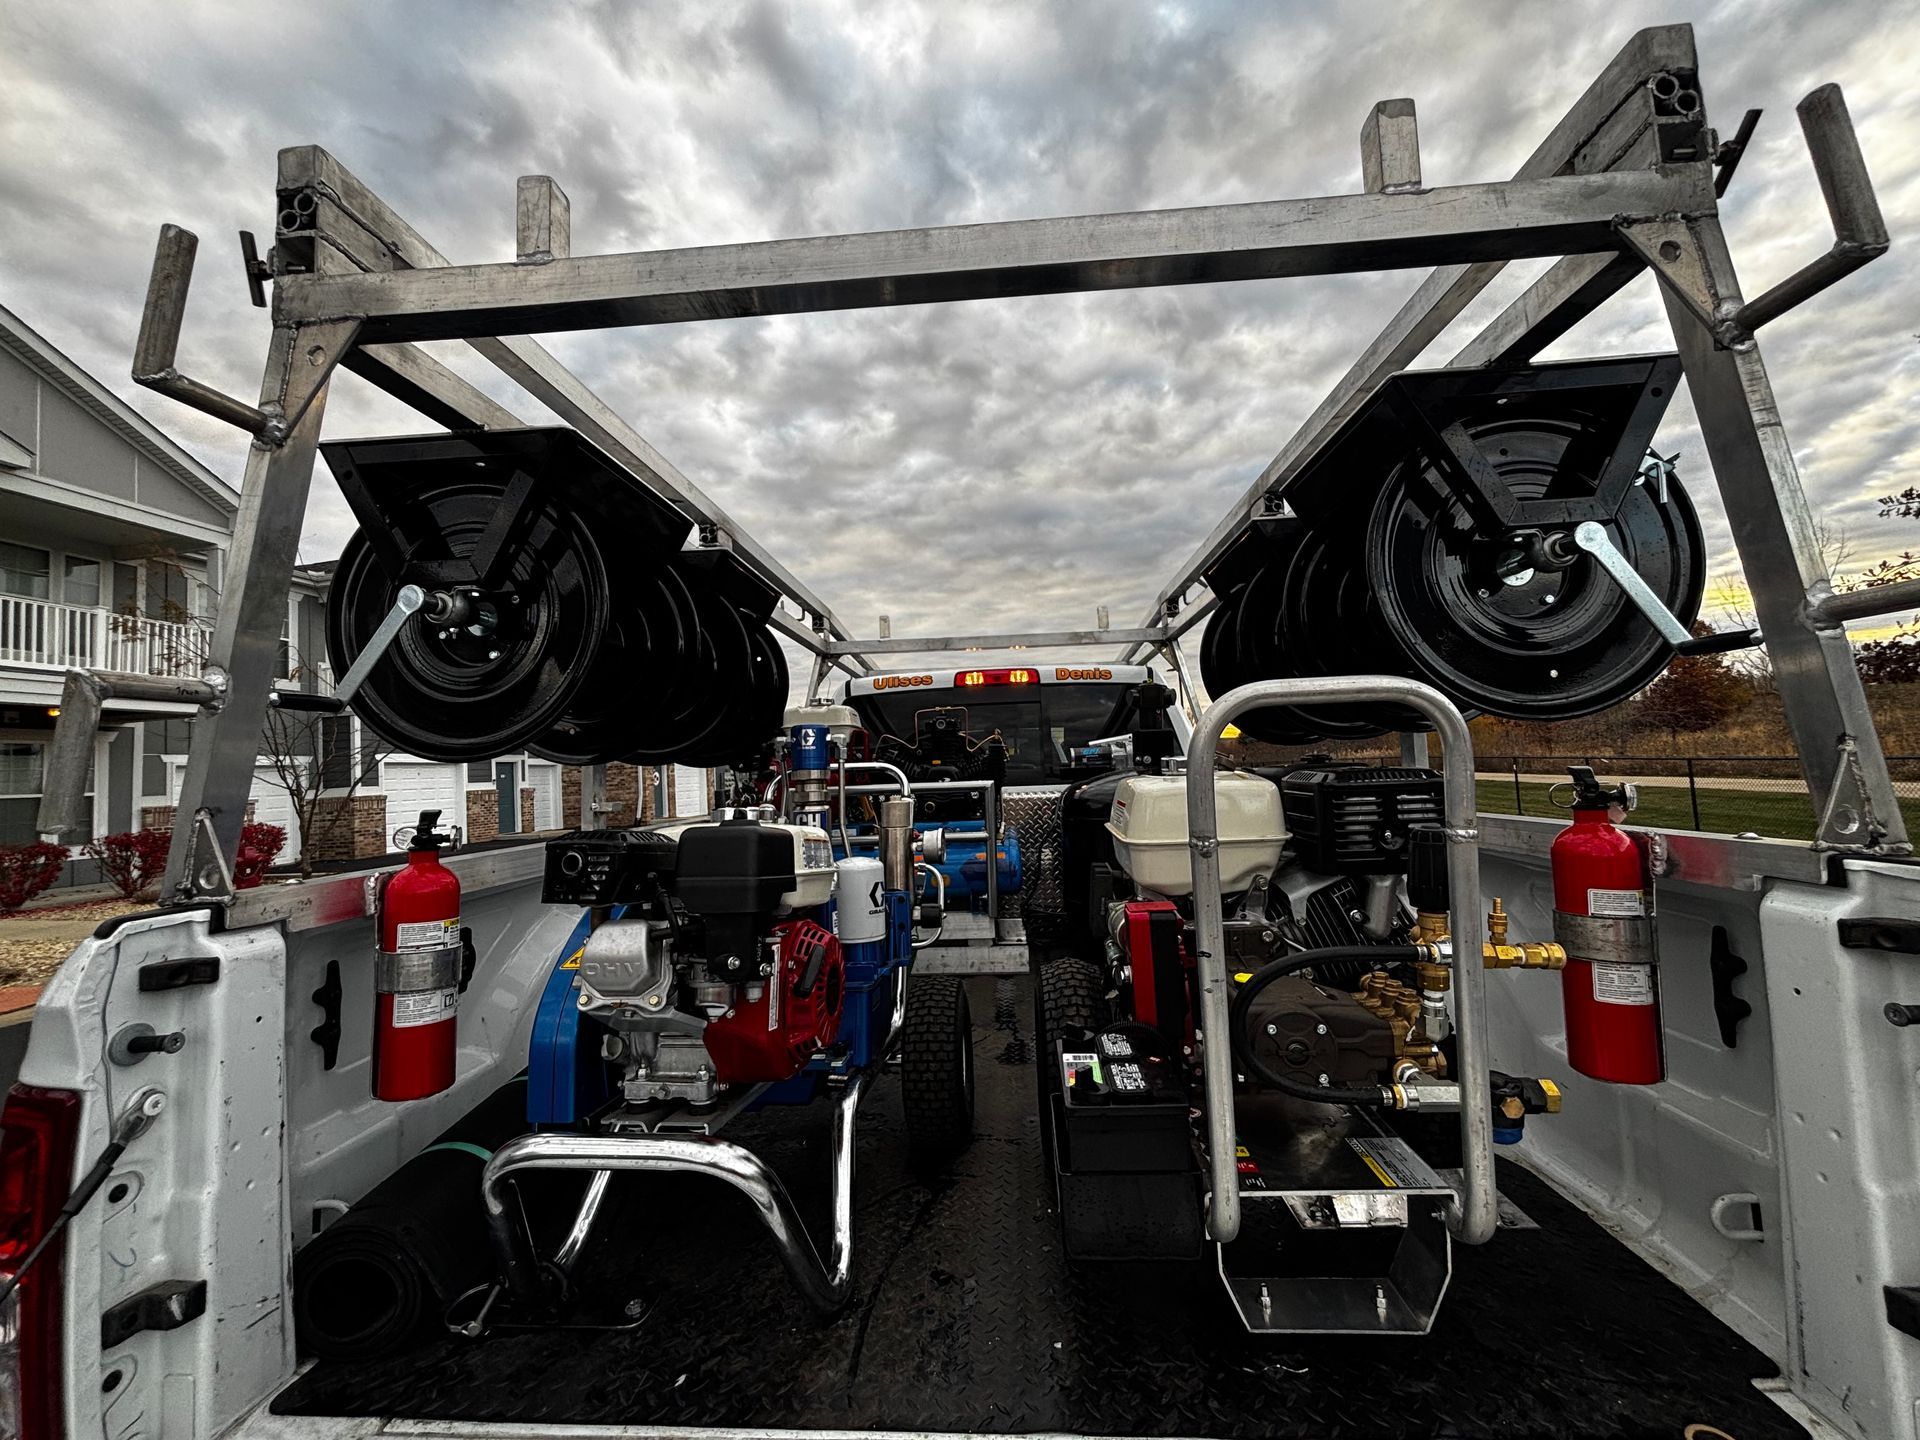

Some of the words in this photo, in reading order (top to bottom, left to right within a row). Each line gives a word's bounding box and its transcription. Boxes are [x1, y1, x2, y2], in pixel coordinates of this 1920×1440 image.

[1055, 667, 1112, 681] Denis
[873, 674, 933, 690] Ulises
[582, 962, 641, 977] OHV
